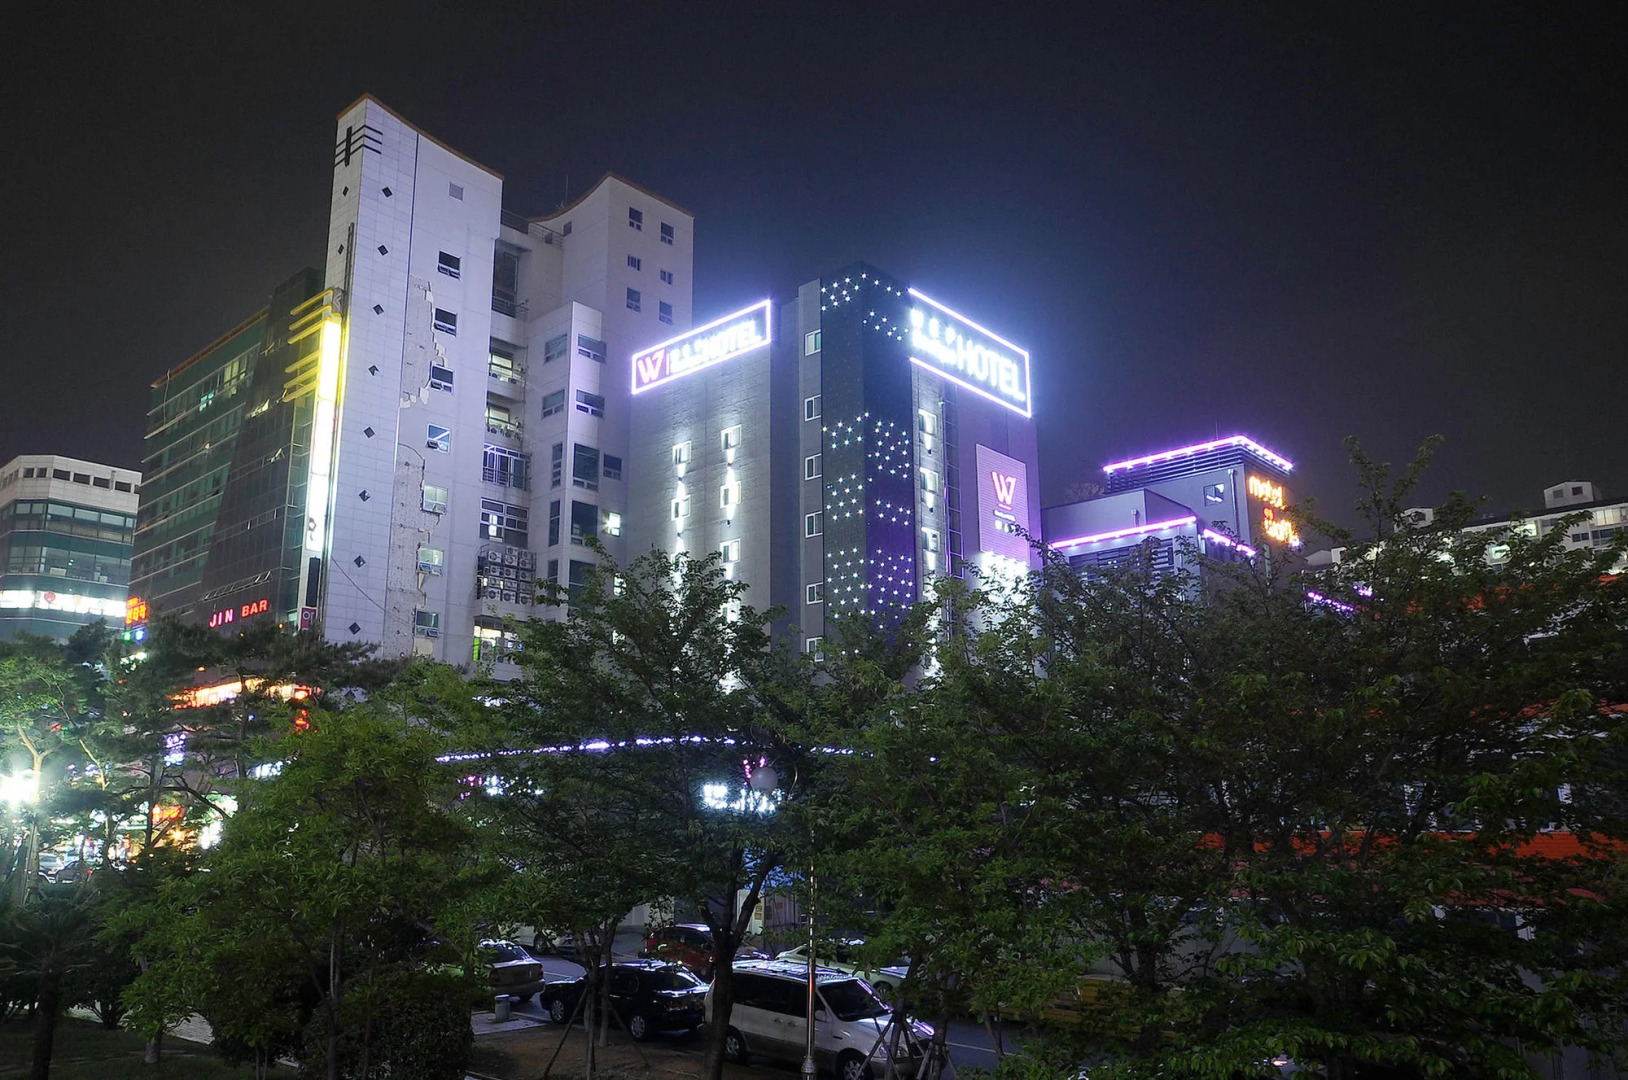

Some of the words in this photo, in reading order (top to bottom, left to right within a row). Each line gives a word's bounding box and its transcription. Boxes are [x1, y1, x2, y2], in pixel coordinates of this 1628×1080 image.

[703, 317, 763, 362] HOTEL
[956, 333, 1026, 402] HOTEL
[209, 608, 234, 628] JIN
[241, 599, 268, 618] BAR
